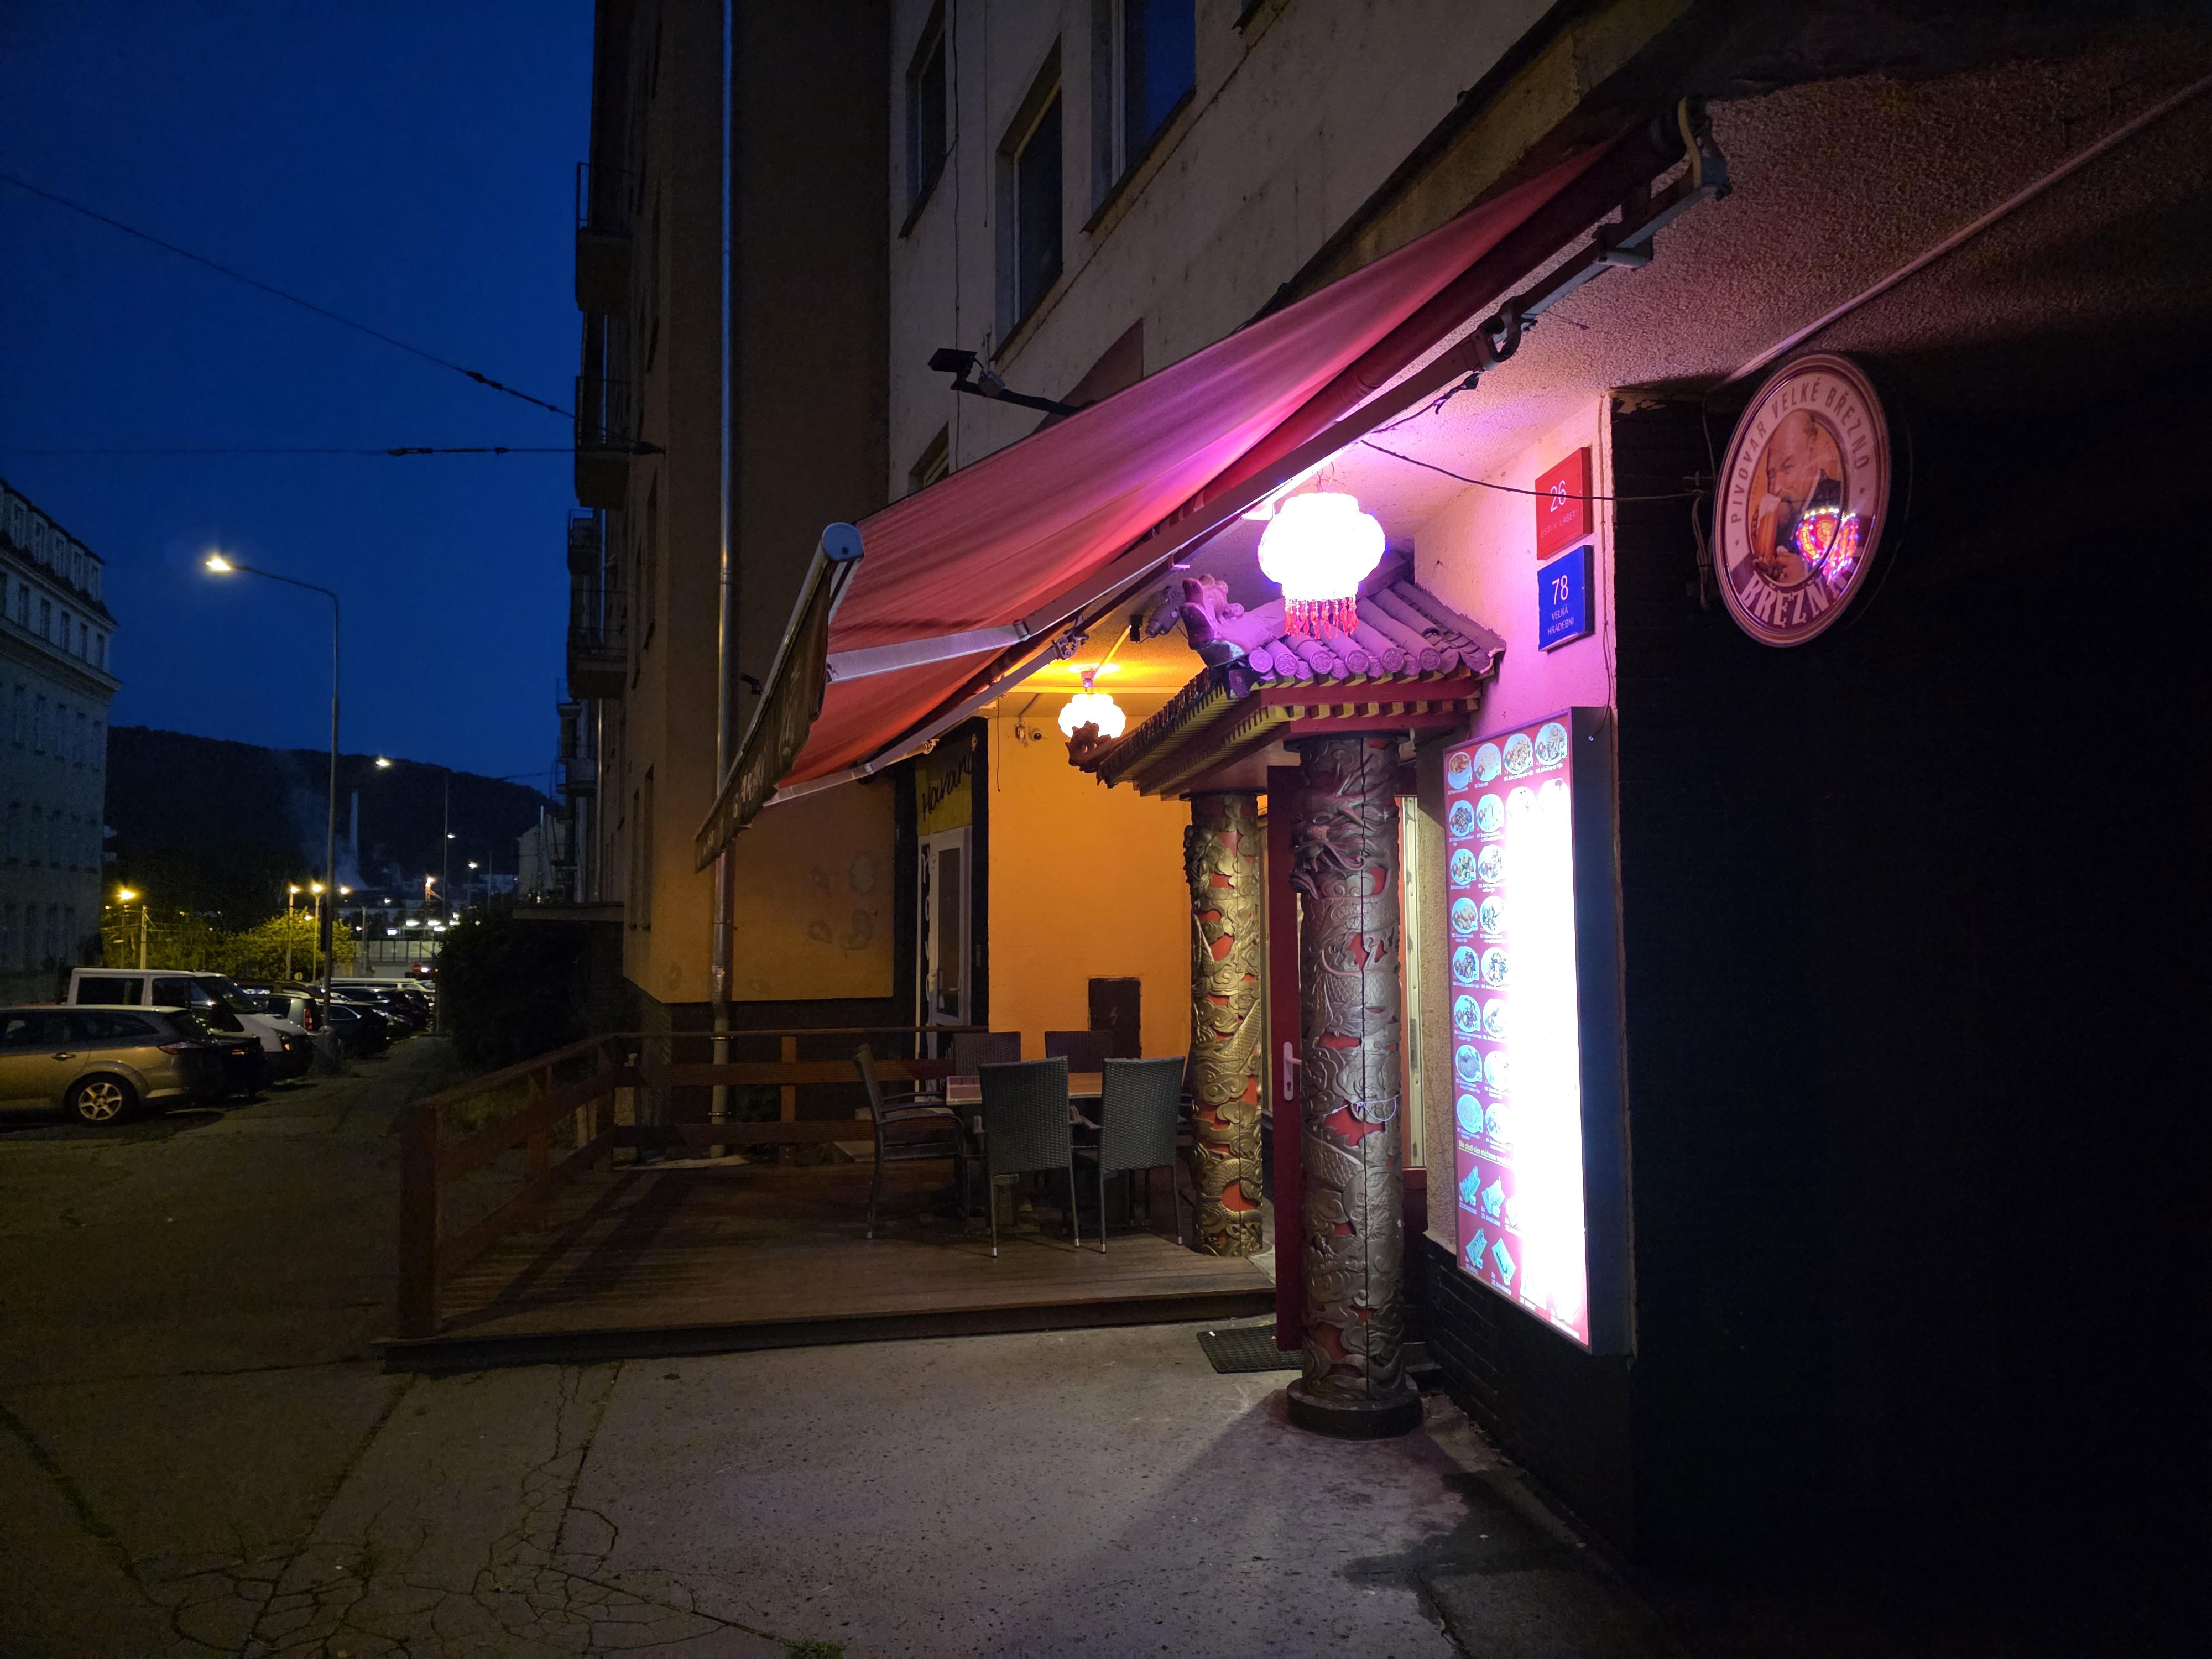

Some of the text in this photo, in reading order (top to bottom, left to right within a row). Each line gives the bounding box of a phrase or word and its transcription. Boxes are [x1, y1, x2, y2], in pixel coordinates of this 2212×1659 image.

[1731, 377, 1870, 524] PIVOVAR VELKÉ BŘEZNO
[1550, 479, 1566, 513] 26
[1552, 575, 1568, 605] 78
